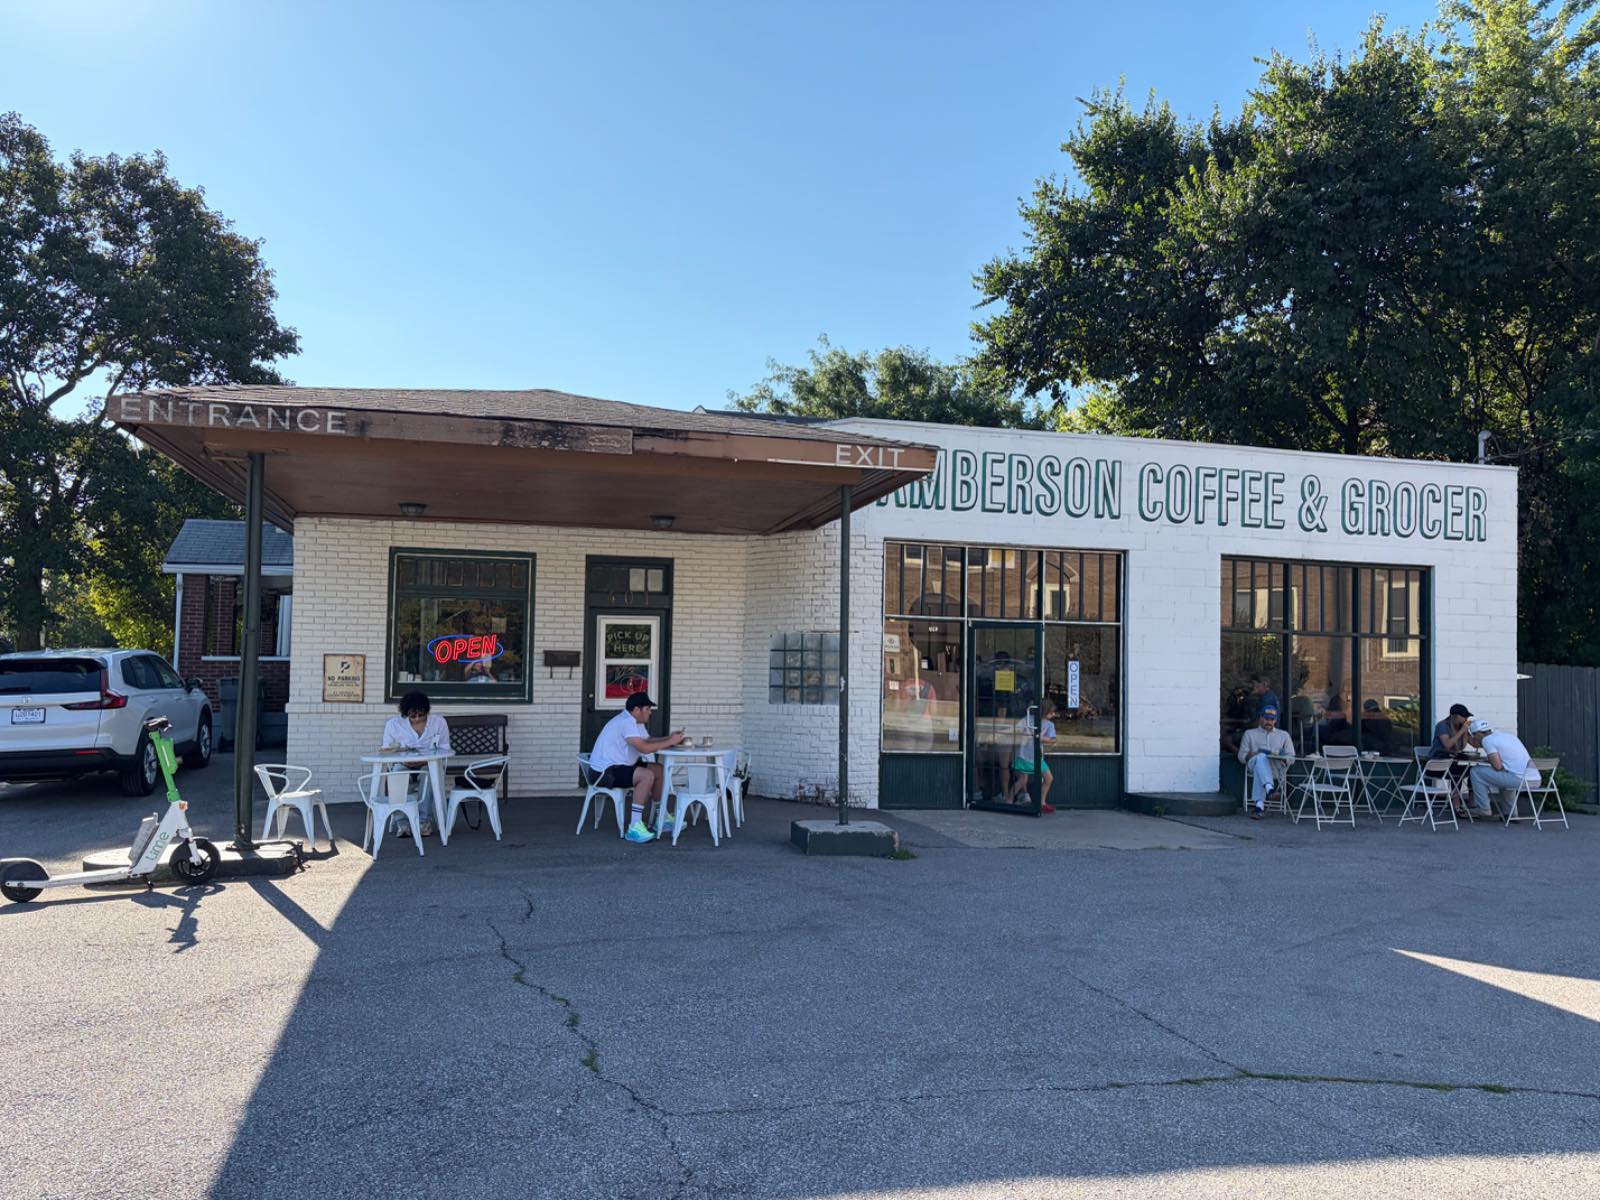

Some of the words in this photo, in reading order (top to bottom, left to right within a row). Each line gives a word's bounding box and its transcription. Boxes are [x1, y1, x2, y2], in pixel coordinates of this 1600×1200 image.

[120, 397, 347, 433] ENTRANCE
[836, 443, 905, 467] EXIT
[1138, 462, 1285, 529] COFFEE
[1298, 474, 1328, 532] &
[1341, 477, 1487, 542] GROCER
[435, 632, 497, 664] OPEN
[607, 631, 631, 642] PICK
[634, 631, 650, 643] UP
[613, 643, 643, 653] HERE
[1069, 662, 1079, 707] OPEN
